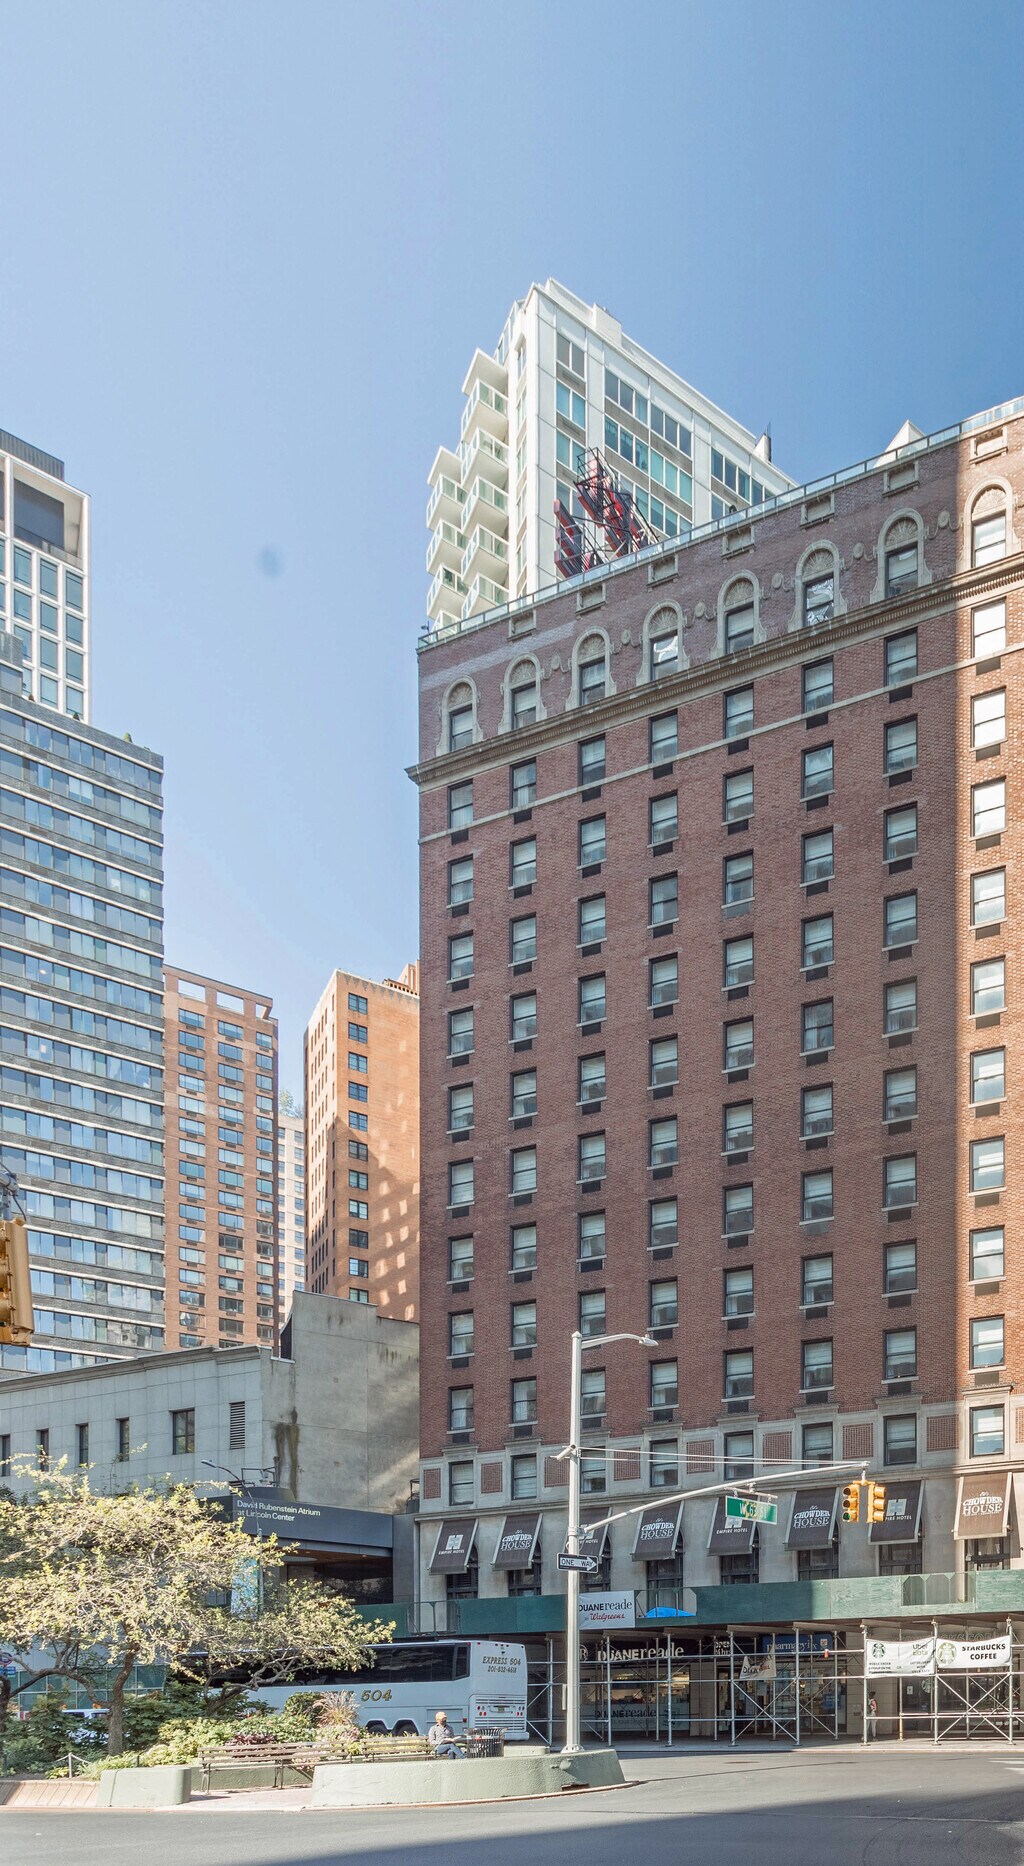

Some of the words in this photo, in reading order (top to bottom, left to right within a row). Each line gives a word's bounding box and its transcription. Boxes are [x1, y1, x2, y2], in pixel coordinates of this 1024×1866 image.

[962, 1496, 1003, 1506] CHOWDER
[237, 1500, 258, 1509] David
[258, 1502, 297, 1514] Rubenstein
[297, 1507, 321, 1516] Atrium
[962, 1503, 1003, 1515] HOUSE
[245, 1510, 272, 1519] Lincoln
[271, 1512, 296, 1521] Center
[793, 1510, 830, 1519] CHOWDER
[641, 1522, 675, 1531] CHOWDER
[793, 1517, 829, 1527] HOUSE
[502, 1533, 533, 1542] CHOWDER
[640, 1529, 674, 1539] HOUSE
[501, 1540, 532, 1550] HOUSE
[561, 1558, 575, 1566] ONE
[589, 1613, 625, 1622] Walgreens
[961, 1643, 1006, 1652] STARBUCKS
[482, 1656, 508, 1665] EXPRESS
[361, 1689, 392, 1702] 504
